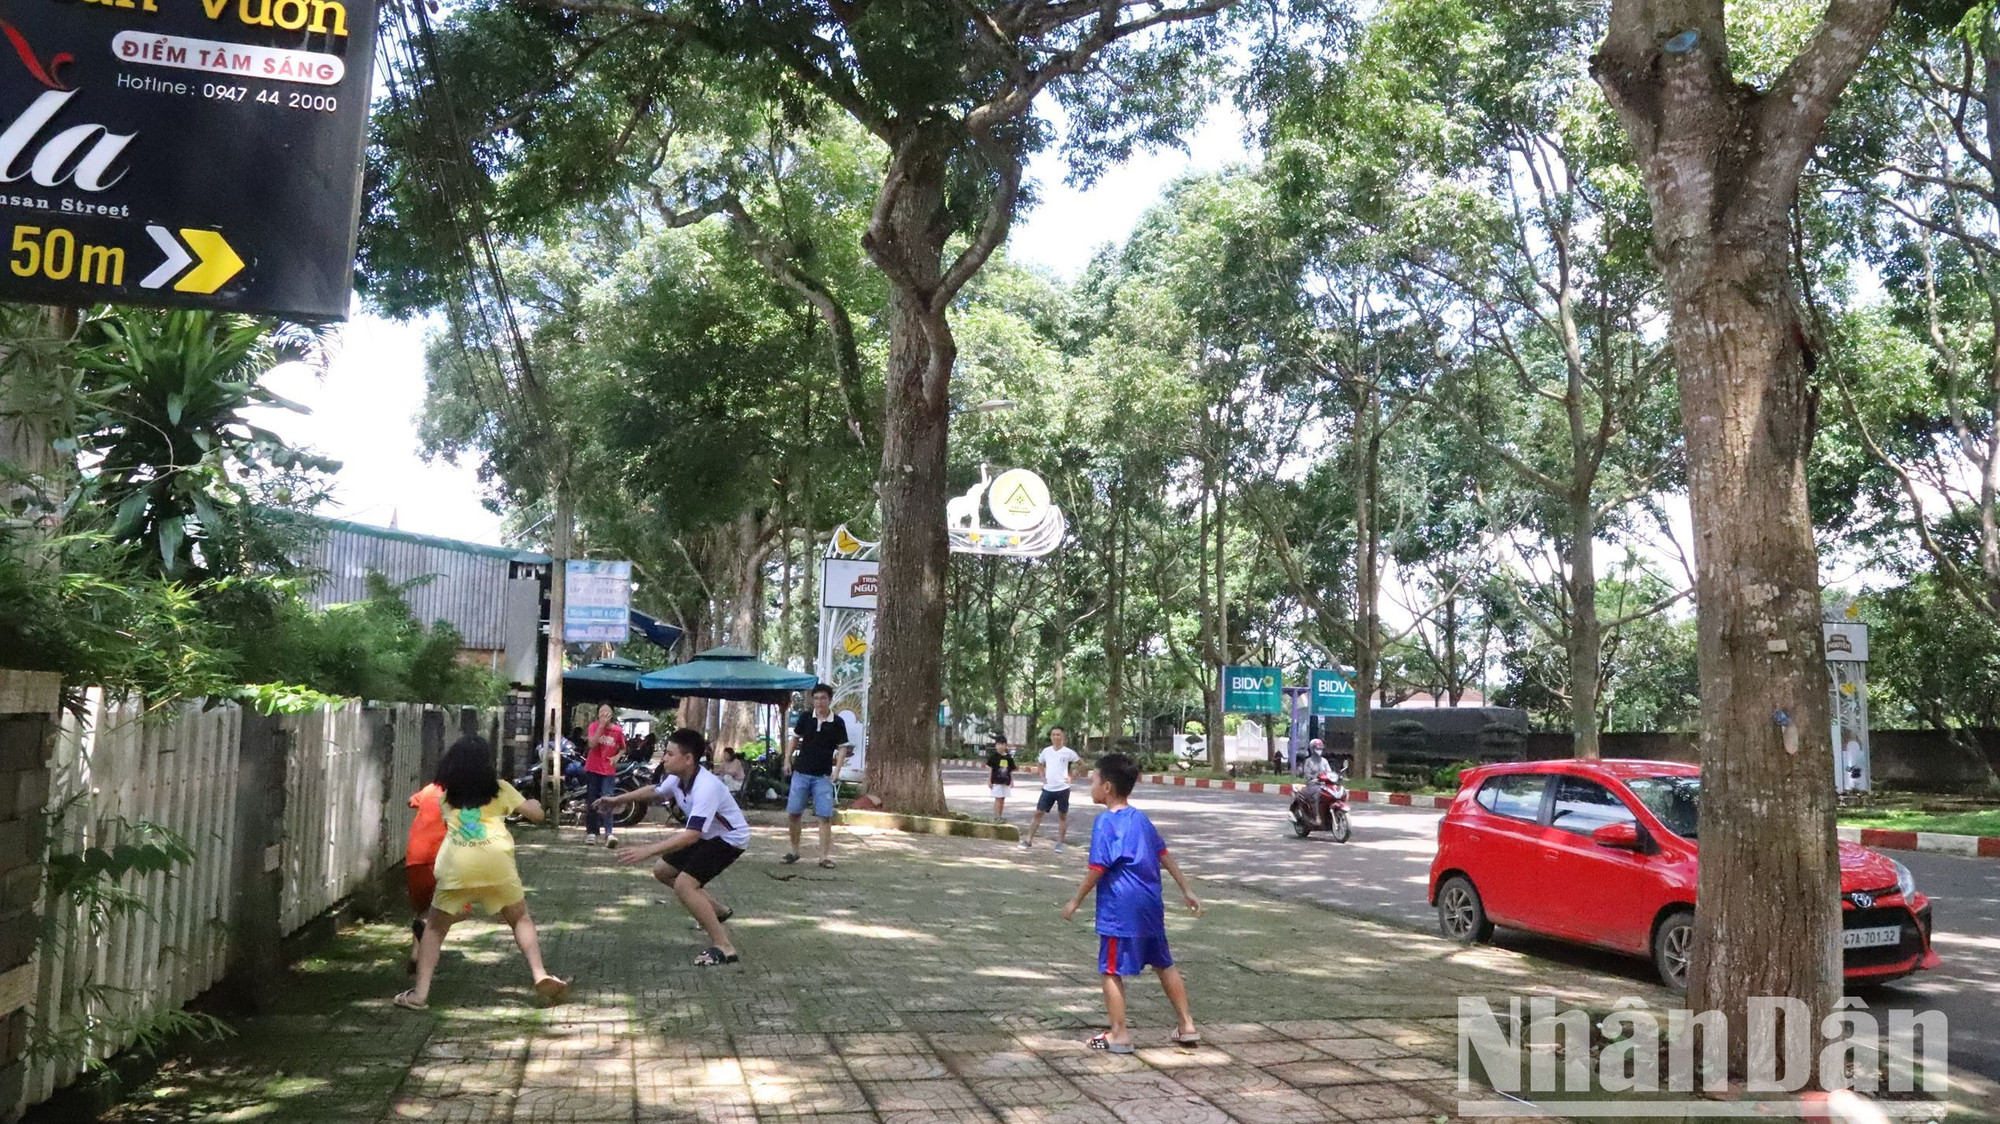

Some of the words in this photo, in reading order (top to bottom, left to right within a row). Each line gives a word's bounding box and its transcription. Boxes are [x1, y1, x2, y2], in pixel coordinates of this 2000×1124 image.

[121, 37, 187, 64] ĐIỂM
[198, 47, 252, 71] TÂM
[263, 55, 335, 81] SÁNG
[203, 83, 248, 102] 0947
[256, 89, 280, 105] 44
[288, 93, 337, 112] 2000
[61, 198, 129, 217] Street
[10, 225, 125, 286] 50m
[853, 583, 878, 593] NGUY
[1232, 676, 1263, 690] BIDV
[1318, 679, 1349, 693] BIDV
